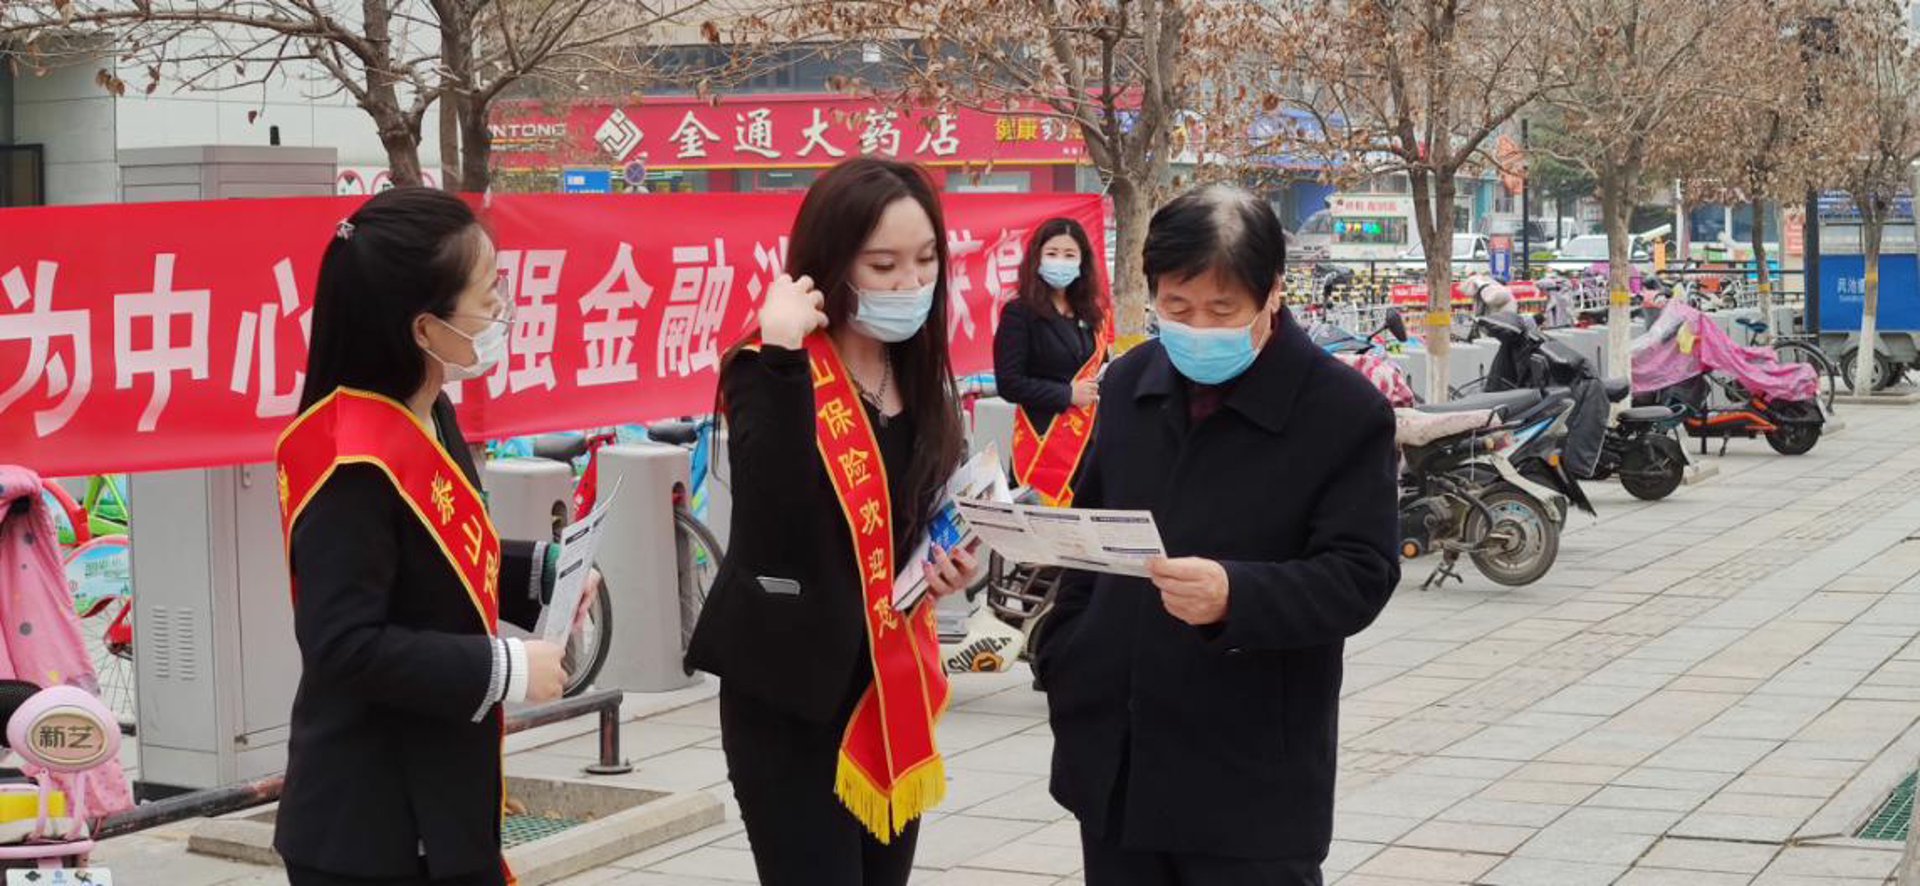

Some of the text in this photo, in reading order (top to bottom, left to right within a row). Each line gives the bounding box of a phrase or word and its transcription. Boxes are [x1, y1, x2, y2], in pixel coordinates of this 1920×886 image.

[487, 123, 567, 137] NTONG
[668, 107, 958, 158] 金通大药店
